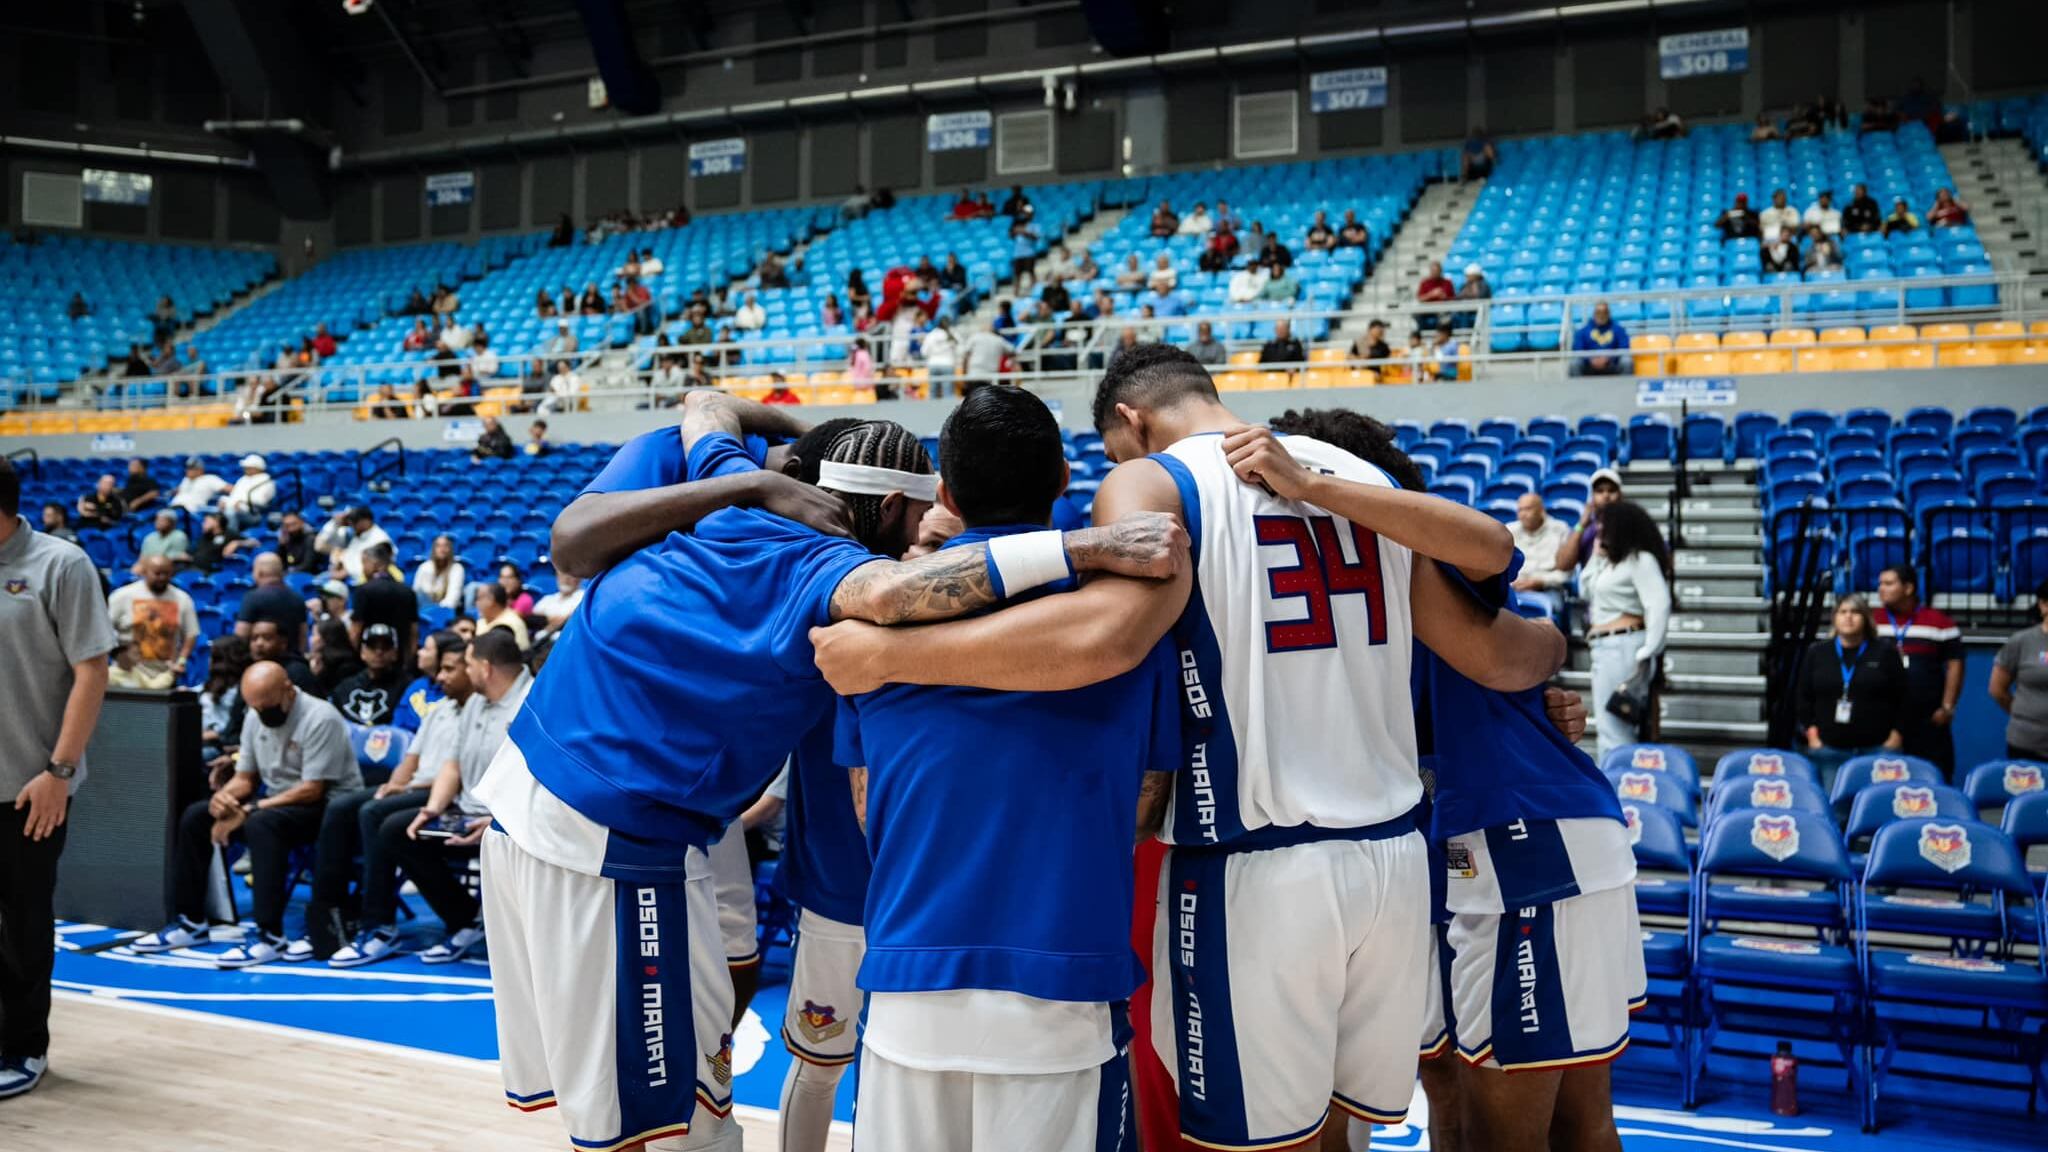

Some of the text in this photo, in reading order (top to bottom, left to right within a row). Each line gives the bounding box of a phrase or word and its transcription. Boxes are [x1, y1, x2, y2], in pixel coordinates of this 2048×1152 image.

[1328, 88, 1369, 110] 307
[1679, 51, 1728, 77] 308
[942, 130, 977, 149] 306
[1253, 514, 1388, 654] 34
[1181, 649, 1213, 719] OSOS
[637, 887, 668, 1088] OSOS MANATI
[1180, 893, 1206, 1101] OSOS MANATI
